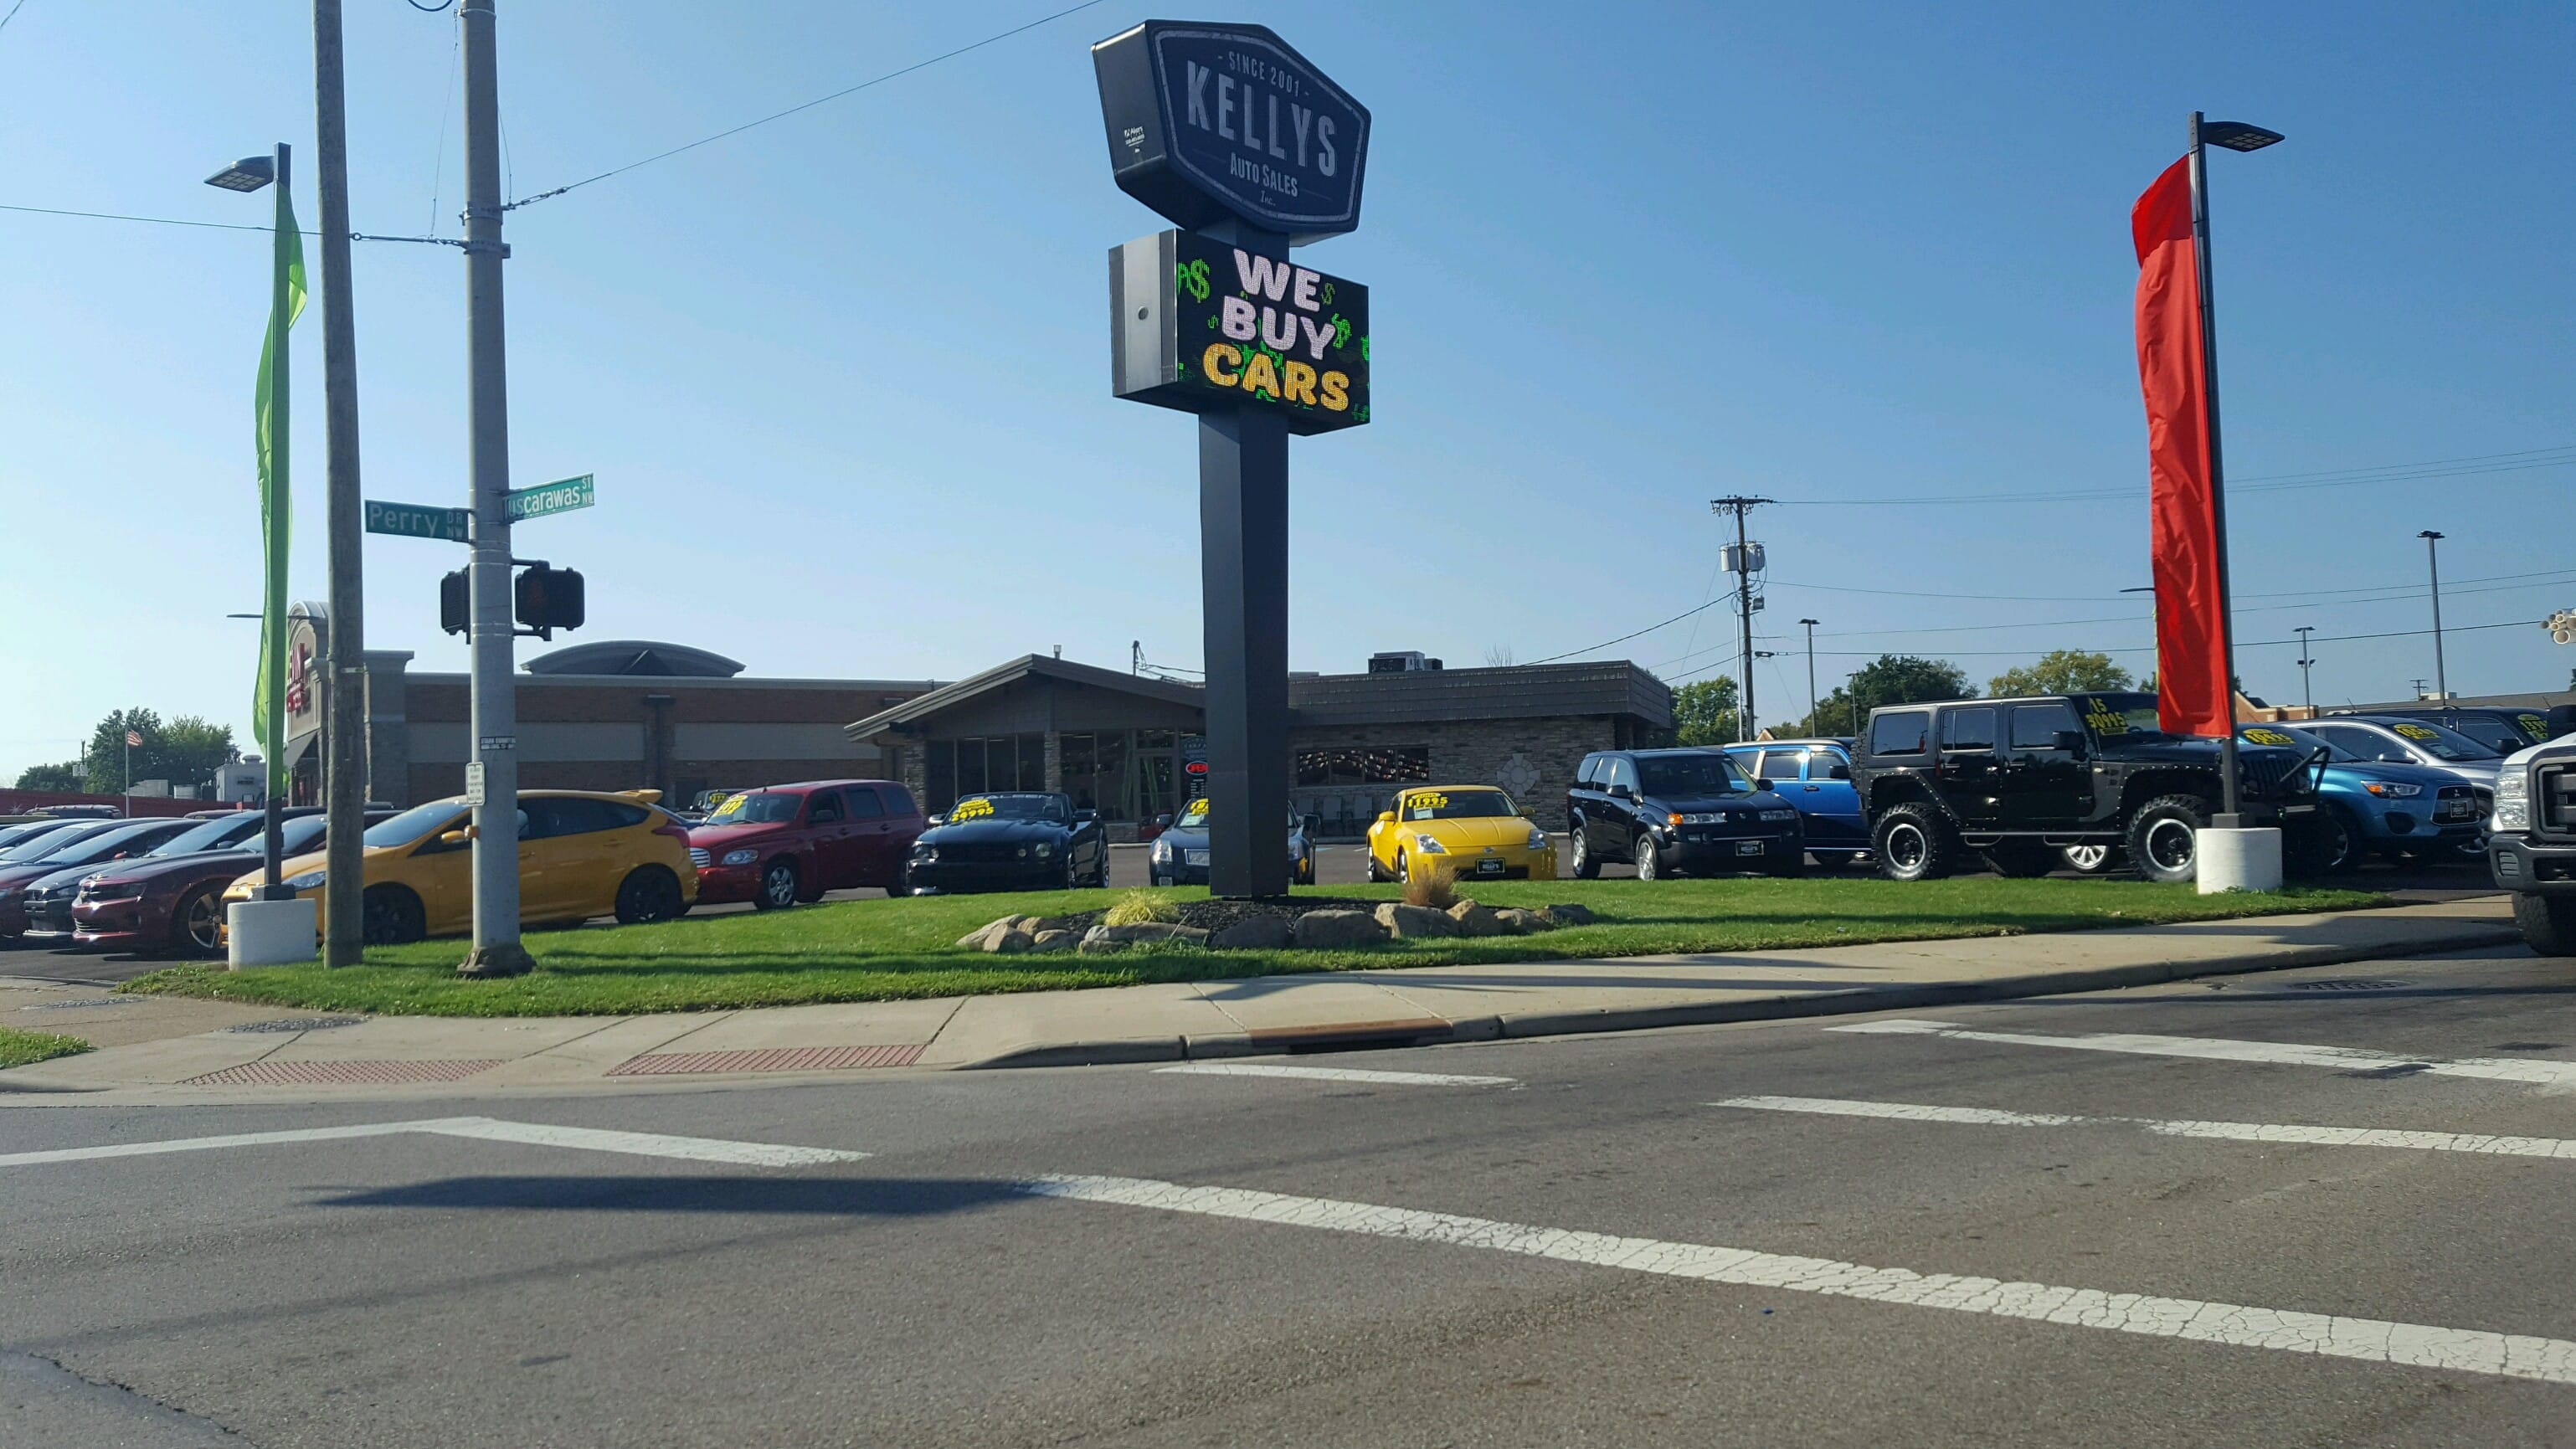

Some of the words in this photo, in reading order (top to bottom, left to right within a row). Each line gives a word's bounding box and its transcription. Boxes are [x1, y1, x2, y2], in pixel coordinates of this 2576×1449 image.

[1228, 51, 1265, 80] SINCE
[1271, 66, 1299, 97] 2001
[1187, 60, 1338, 177] KELLYS
[1231, 152, 1259, 184] AUTO
[1262, 163, 1298, 198] SALES
[1233, 249, 1321, 312] WE
[1222, 295, 1336, 361] BUY
[1202, 342, 1350, 412] CARS
[582, 476, 592, 489] ST
[582, 491, 594, 505] NW
[447, 511, 463, 524] DR
[503, 486, 580, 519] Tuscarawas
[369, 503, 438, 537] Perry
[447, 527, 463, 538] NW
[2089, 697, 2107, 712] 15
[1407, 796, 1448, 808] 11995
